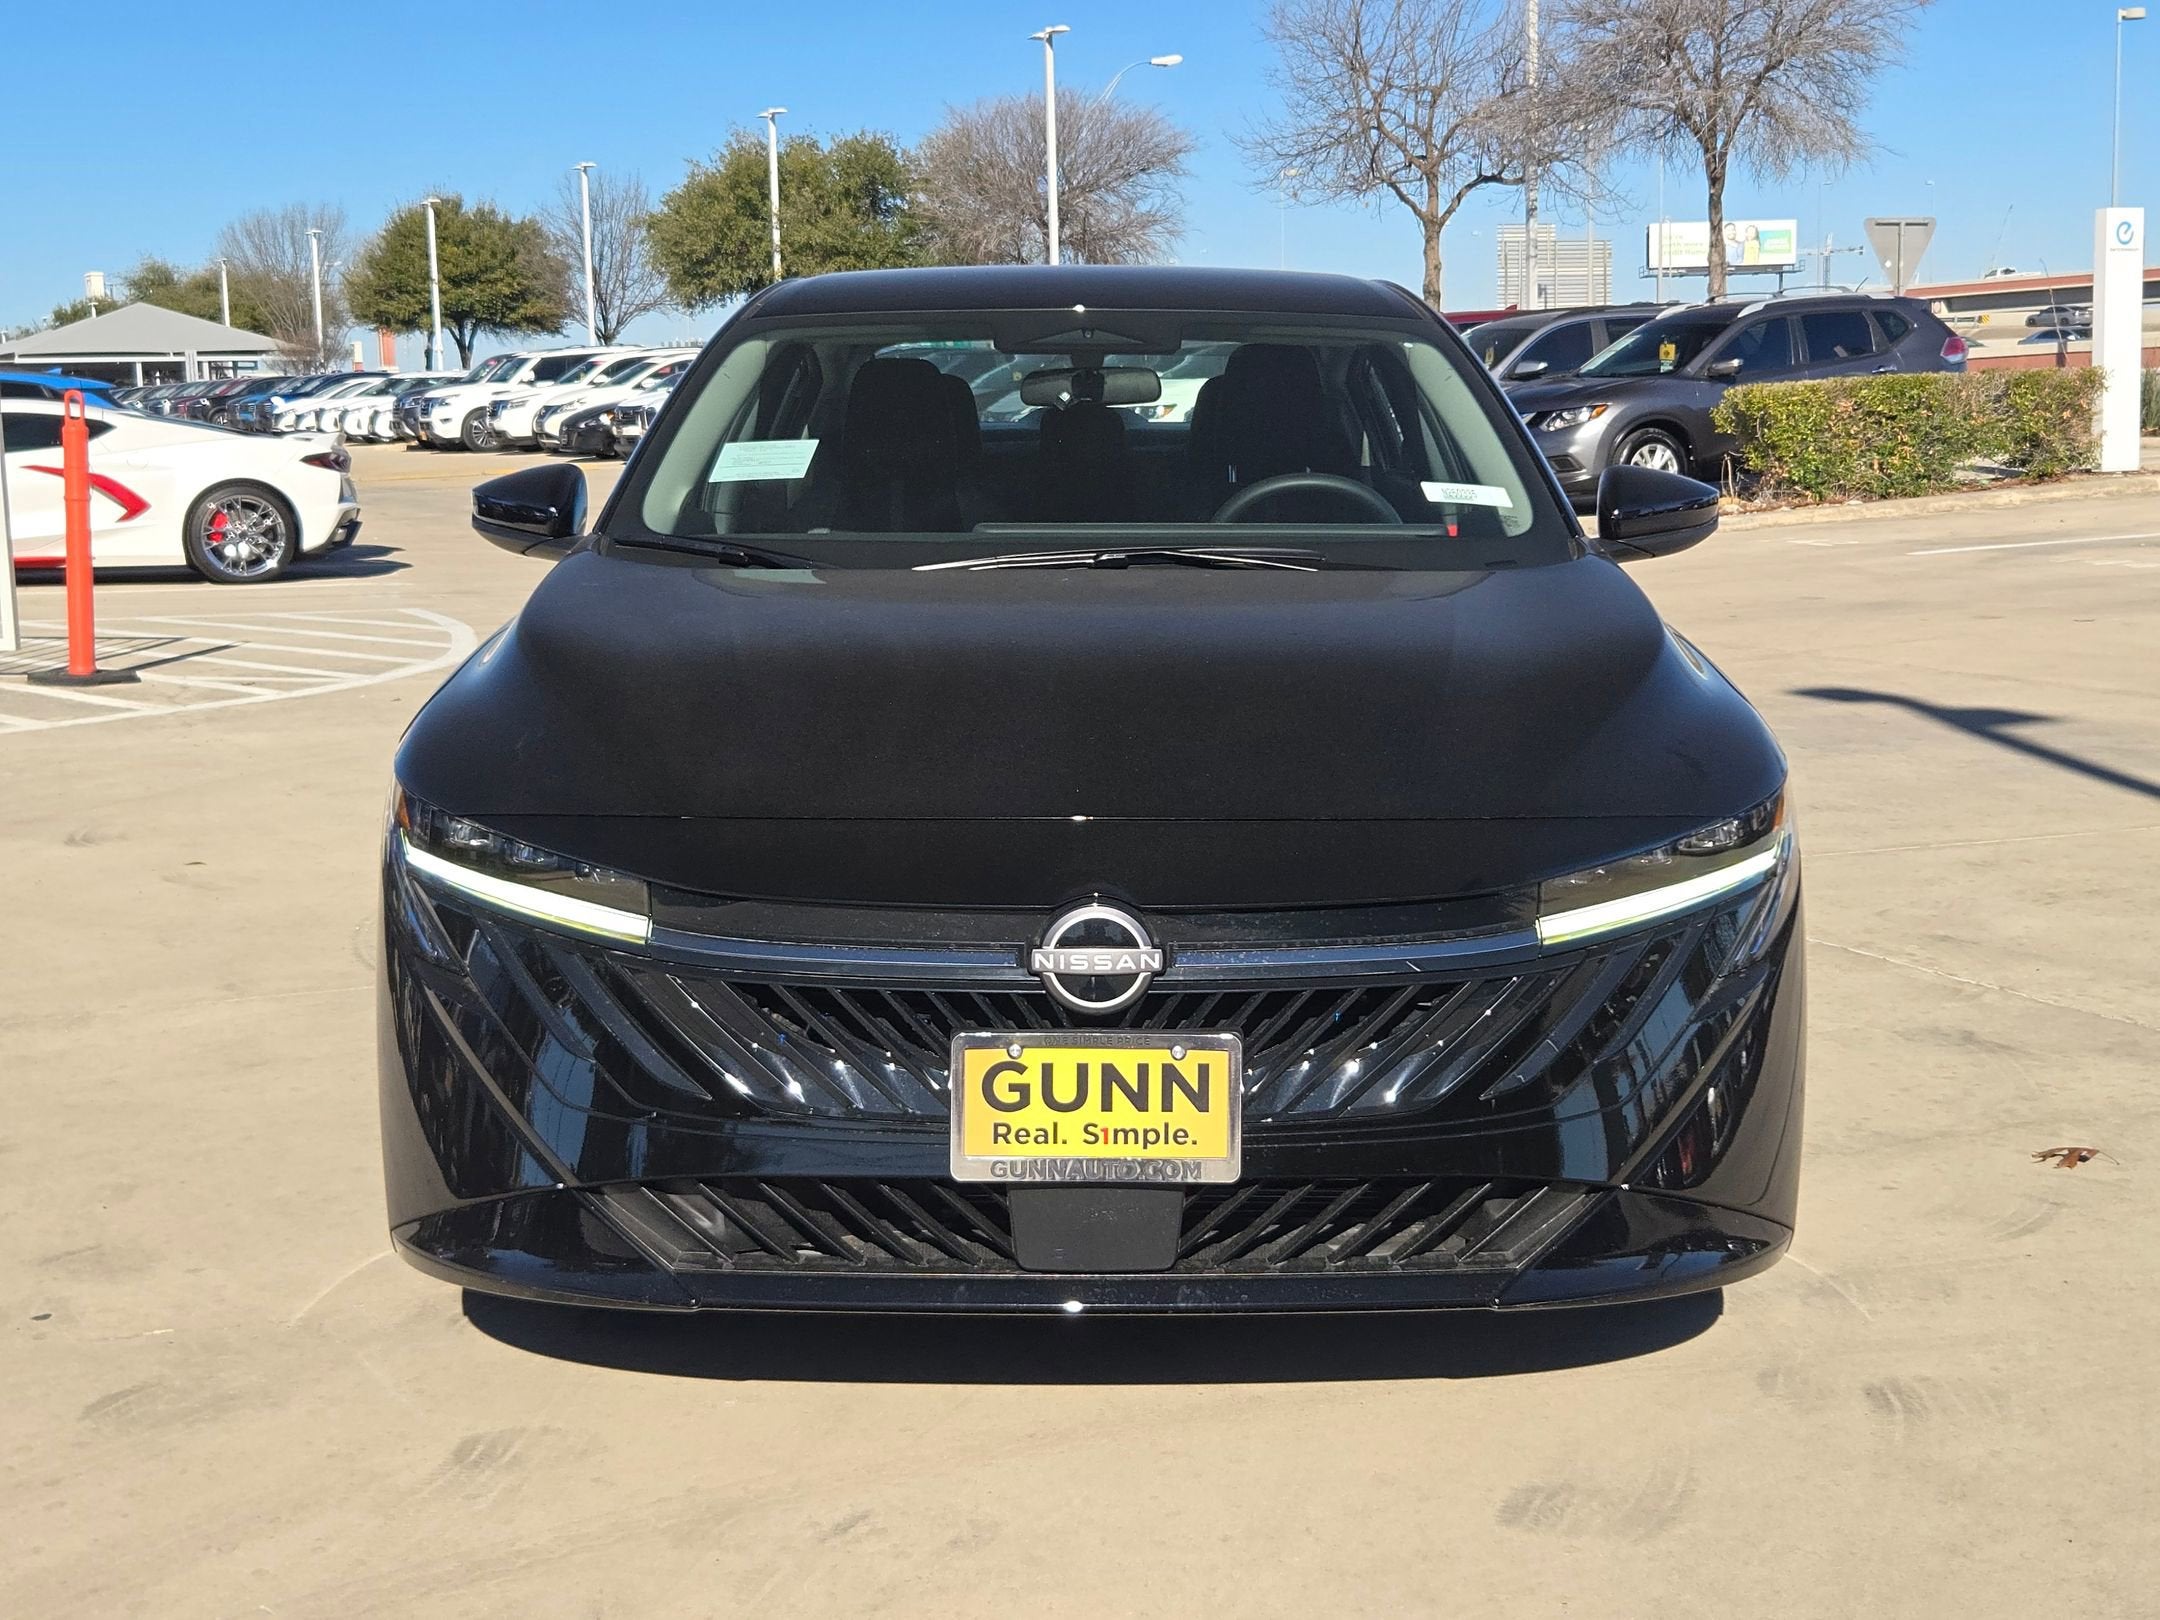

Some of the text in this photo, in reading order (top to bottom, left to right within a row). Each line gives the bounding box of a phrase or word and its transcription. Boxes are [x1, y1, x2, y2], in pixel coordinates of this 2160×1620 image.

[1034, 953, 1160, 971] NISSAN
[1071, 1036, 1113, 1047] SIMPLE
[1116, 1036, 1151, 1047] PRICE
[981, 1060, 1210, 1113] GUNN
[992, 1122, 1068, 1145] Real.
[990, 1159, 1203, 1181] GUNNAUTO.COM
